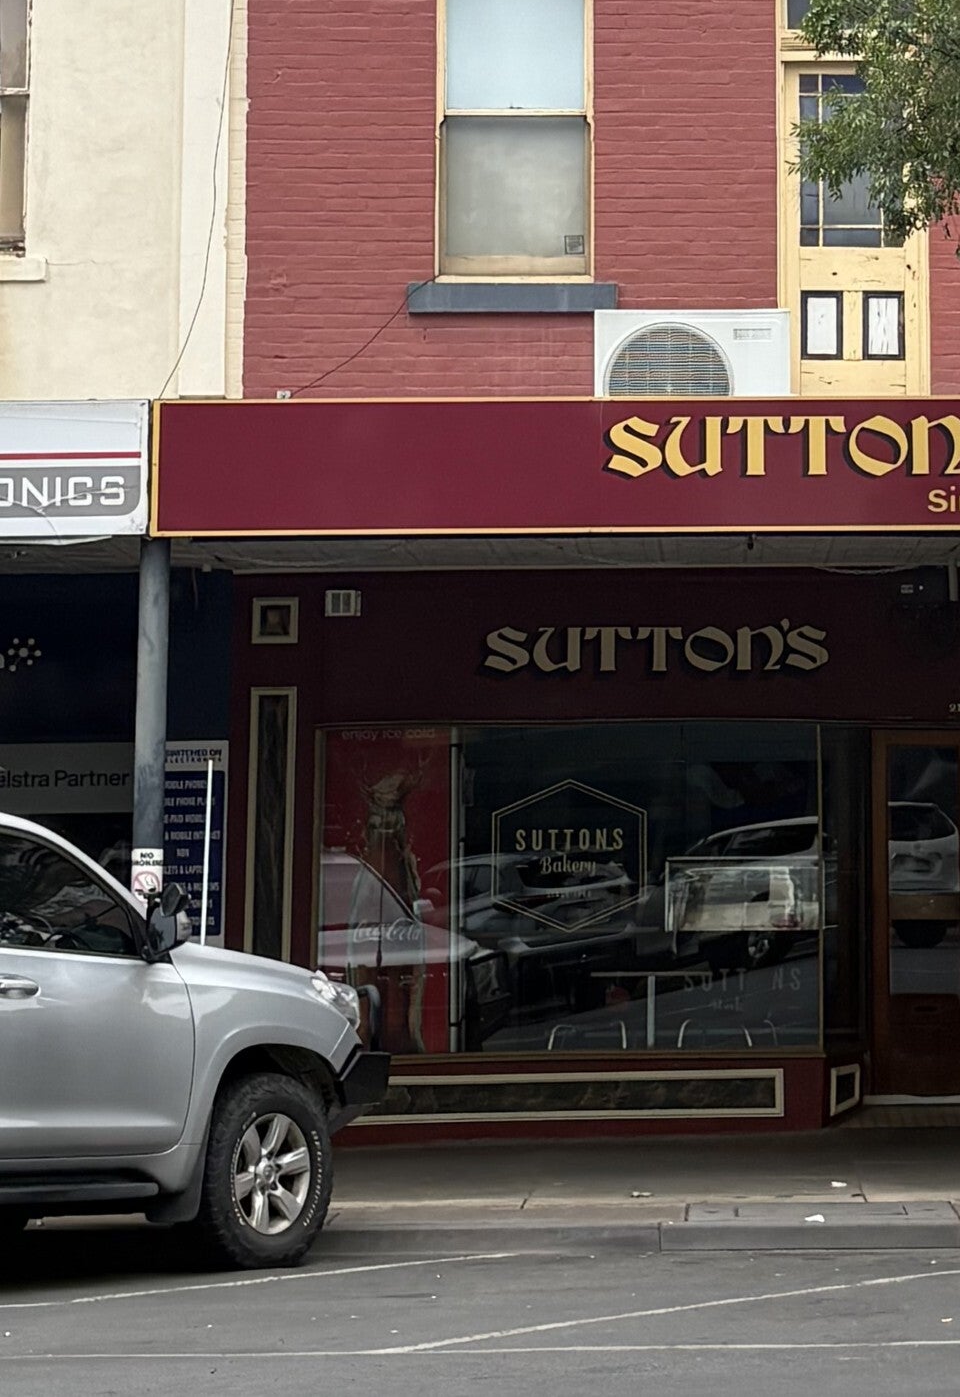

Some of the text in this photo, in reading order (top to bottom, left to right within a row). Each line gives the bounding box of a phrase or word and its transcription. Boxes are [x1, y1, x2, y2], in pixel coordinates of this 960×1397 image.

[484, 618, 829, 674] SUTTON'S
[54, 769, 130, 789] Partner
[515, 827, 624, 852] SUTTONS
[539, 855, 597, 876] Bakery
